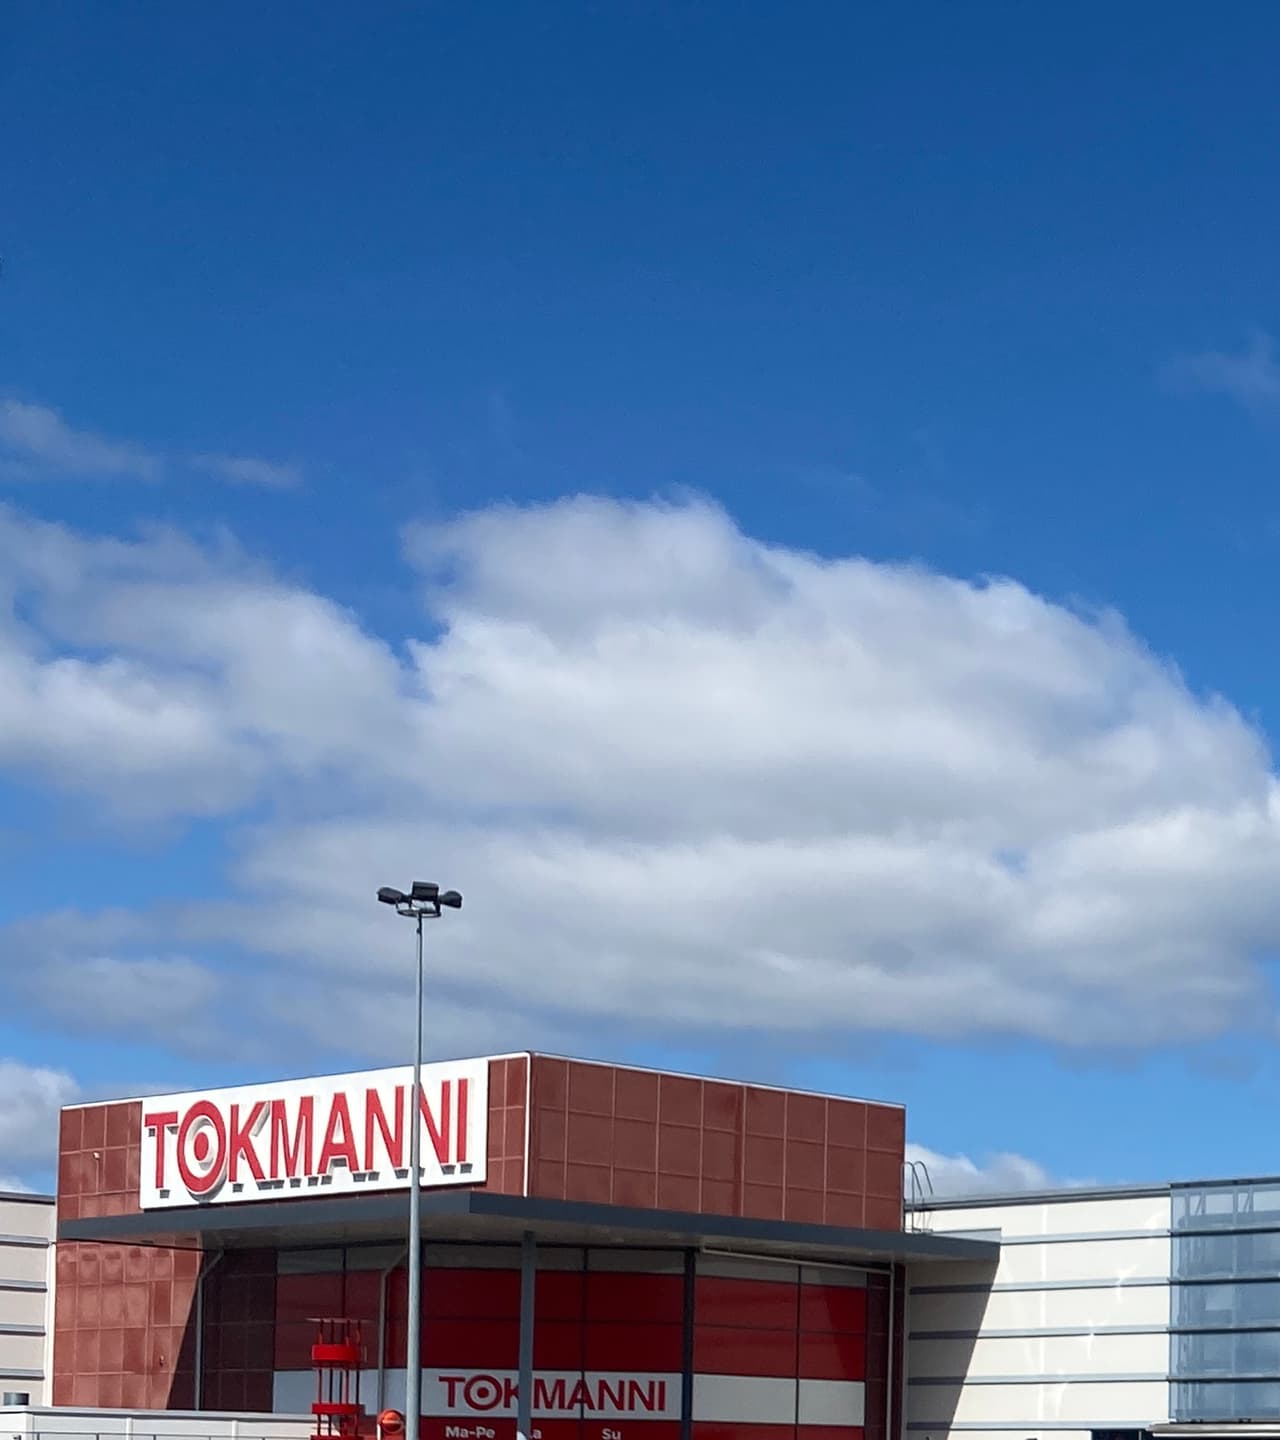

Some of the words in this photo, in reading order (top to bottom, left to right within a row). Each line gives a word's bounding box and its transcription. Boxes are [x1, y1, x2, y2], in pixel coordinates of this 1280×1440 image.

[145, 1078, 468, 1193] TOKMANNI
[439, 1375, 666, 1411] TOKMANNI
[445, 1426, 495, 1439] Ma-Pe
[602, 1428, 621, 1440] Su
